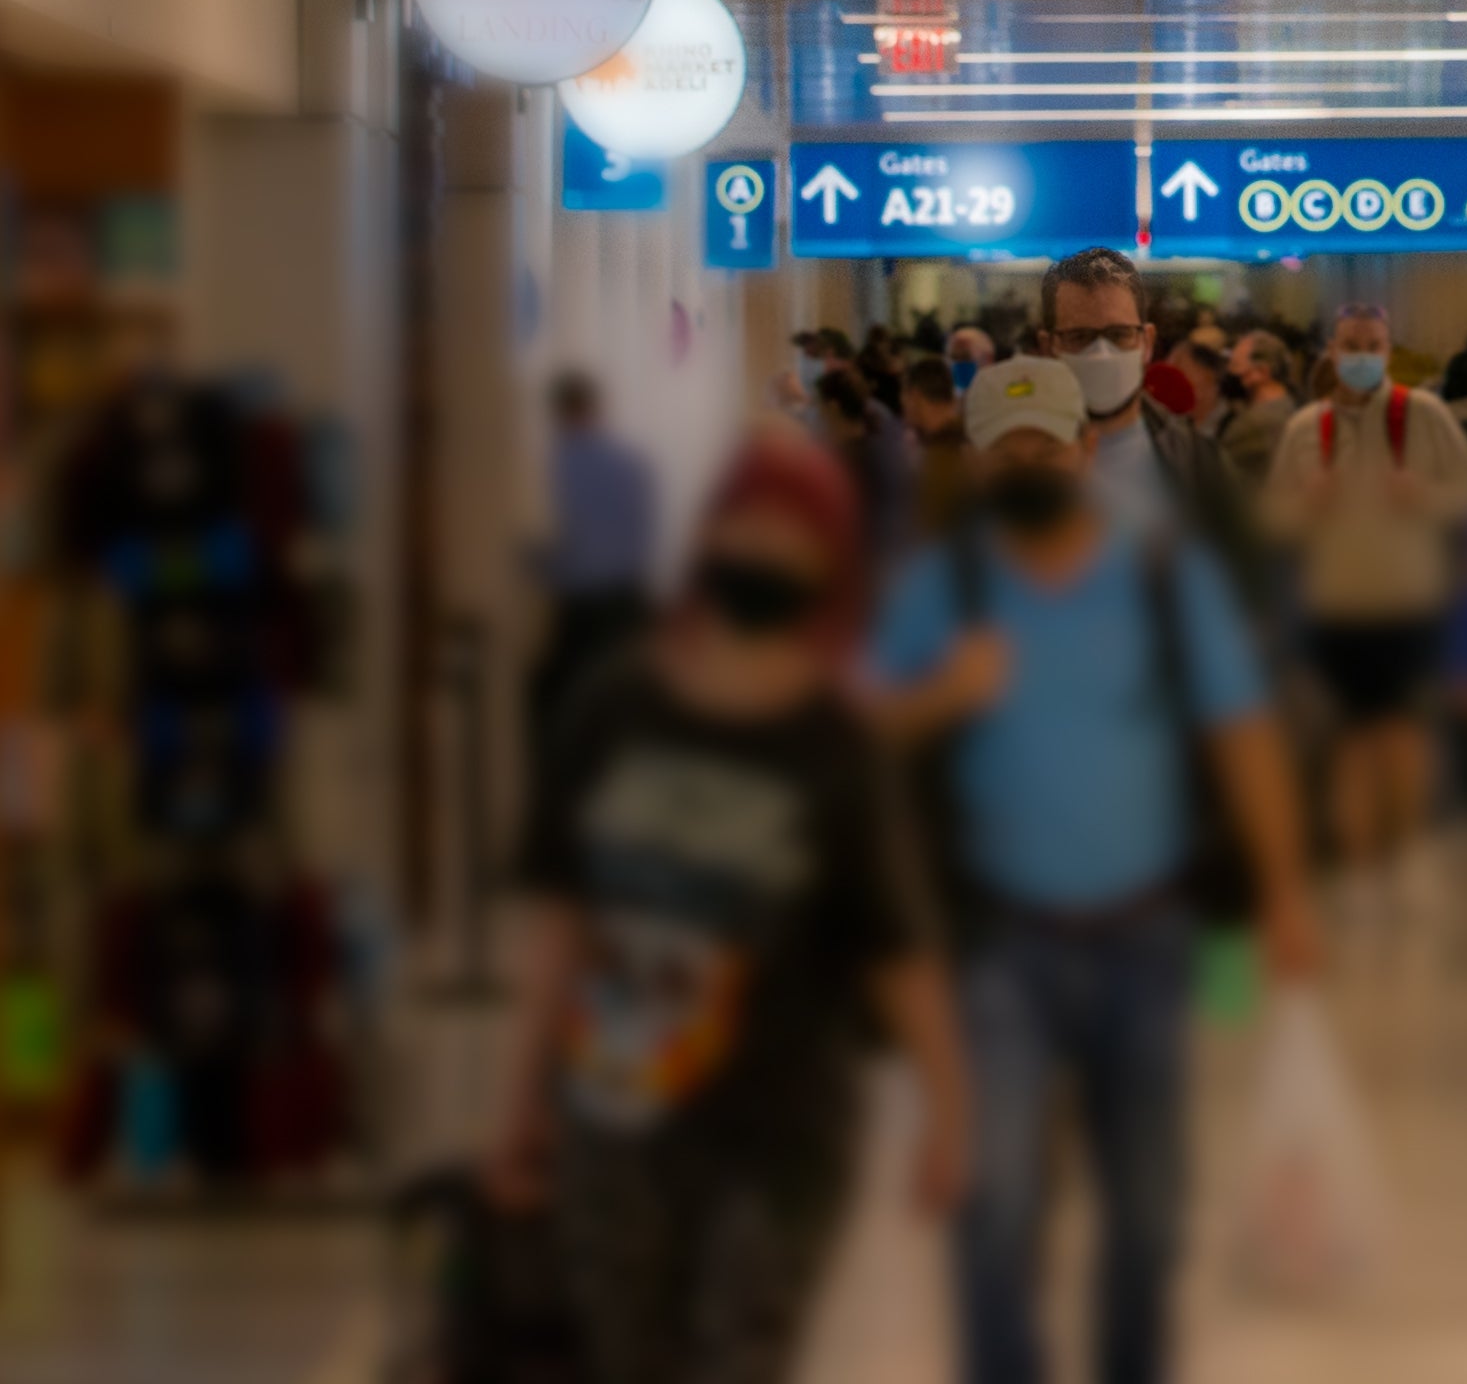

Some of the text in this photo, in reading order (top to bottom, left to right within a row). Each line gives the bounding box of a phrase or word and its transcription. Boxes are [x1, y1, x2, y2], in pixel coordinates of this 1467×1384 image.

[458, 15, 608, 44] LANDING
[879, 151, 948, 176] Gates
[728, 175, 753, 203] A
[1356, 189, 1382, 218] D
[881, 186, 1015, 226] A21-29
[1302, 190, 1326, 219] C
[729, 214, 748, 250] 1
